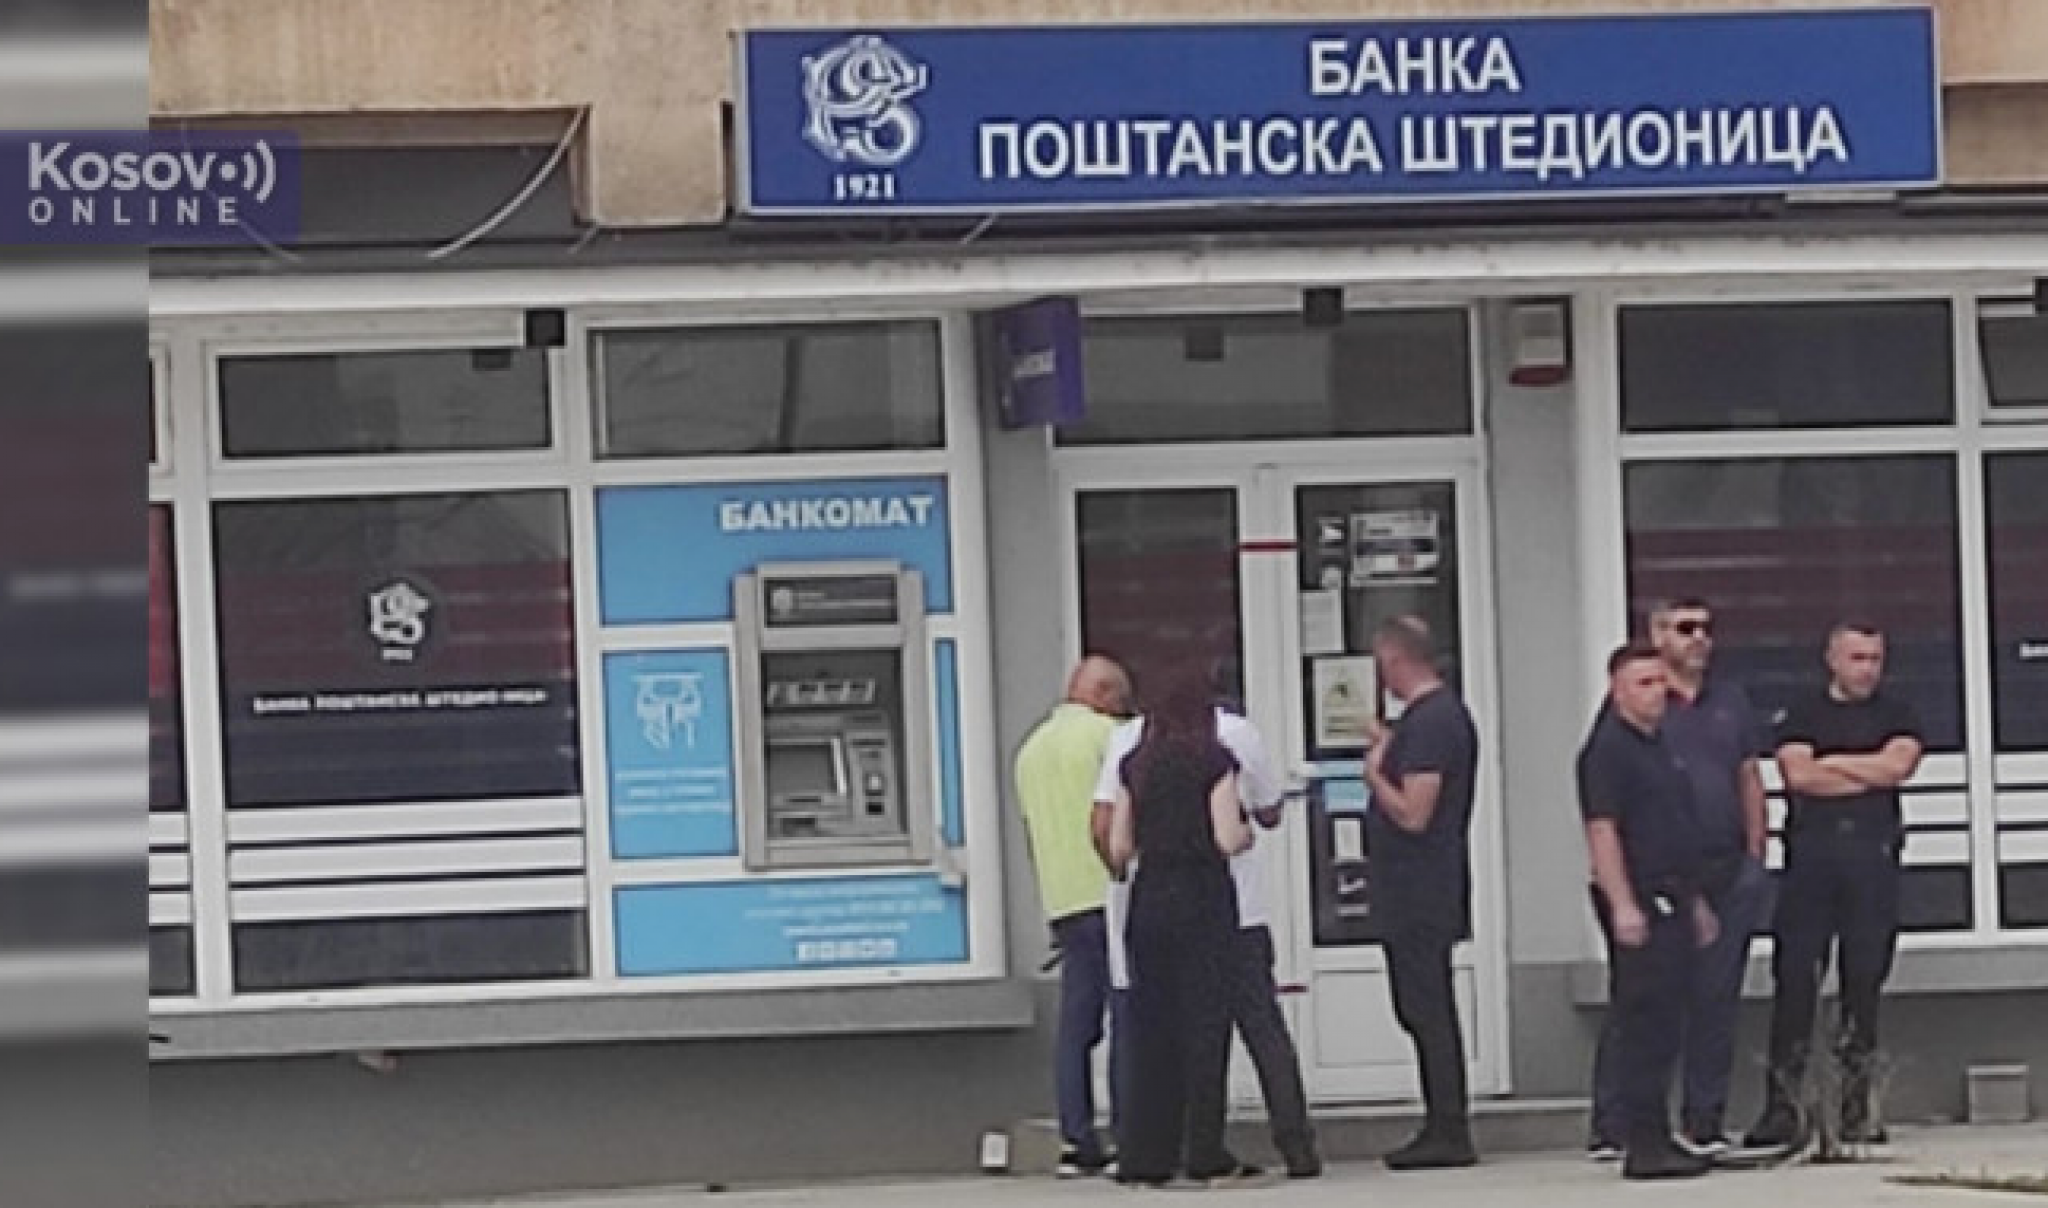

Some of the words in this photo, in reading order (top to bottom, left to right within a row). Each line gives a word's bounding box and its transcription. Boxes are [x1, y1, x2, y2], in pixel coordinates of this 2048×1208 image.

[1309, 37, 1521, 95] БАНКА
[979, 115, 1383, 178] ПОШТАНСКА
[1401, 106, 1847, 179] ШТЕДИОНИЦА
[834, 173, 895, 200] 1921
[720, 496, 933, 531] БАНКОМАТ
